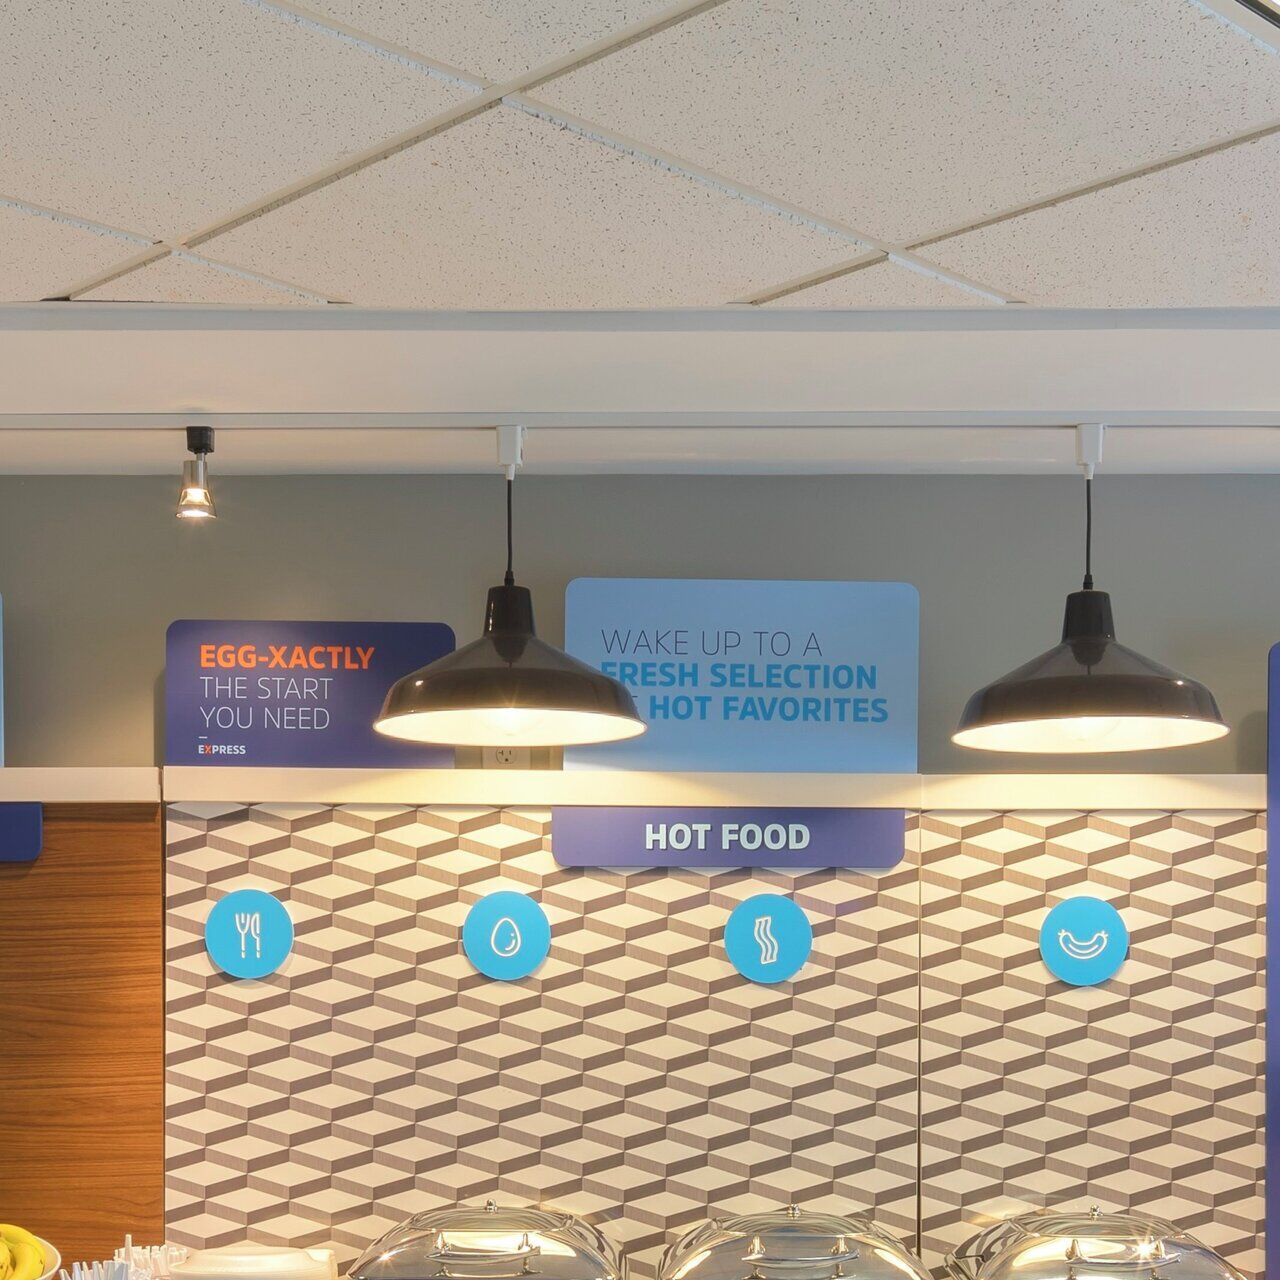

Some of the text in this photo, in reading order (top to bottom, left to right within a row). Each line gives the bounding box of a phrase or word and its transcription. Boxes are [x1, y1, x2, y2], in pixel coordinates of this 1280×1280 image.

[601, 629, 823, 657] WAKE UP TO A
[200, 644, 376, 670] EGG-XACTLY
[200, 676, 333, 700] THE START
[601, 661, 877, 690] FRESH SELECTION
[200, 706, 331, 730] YOU NEED
[649, 695, 713, 720] HOT
[723, 696, 889, 723] FAVORITES
[198, 744, 246, 755] EXPRESS
[645, 823, 810, 850] HOT FOOD
